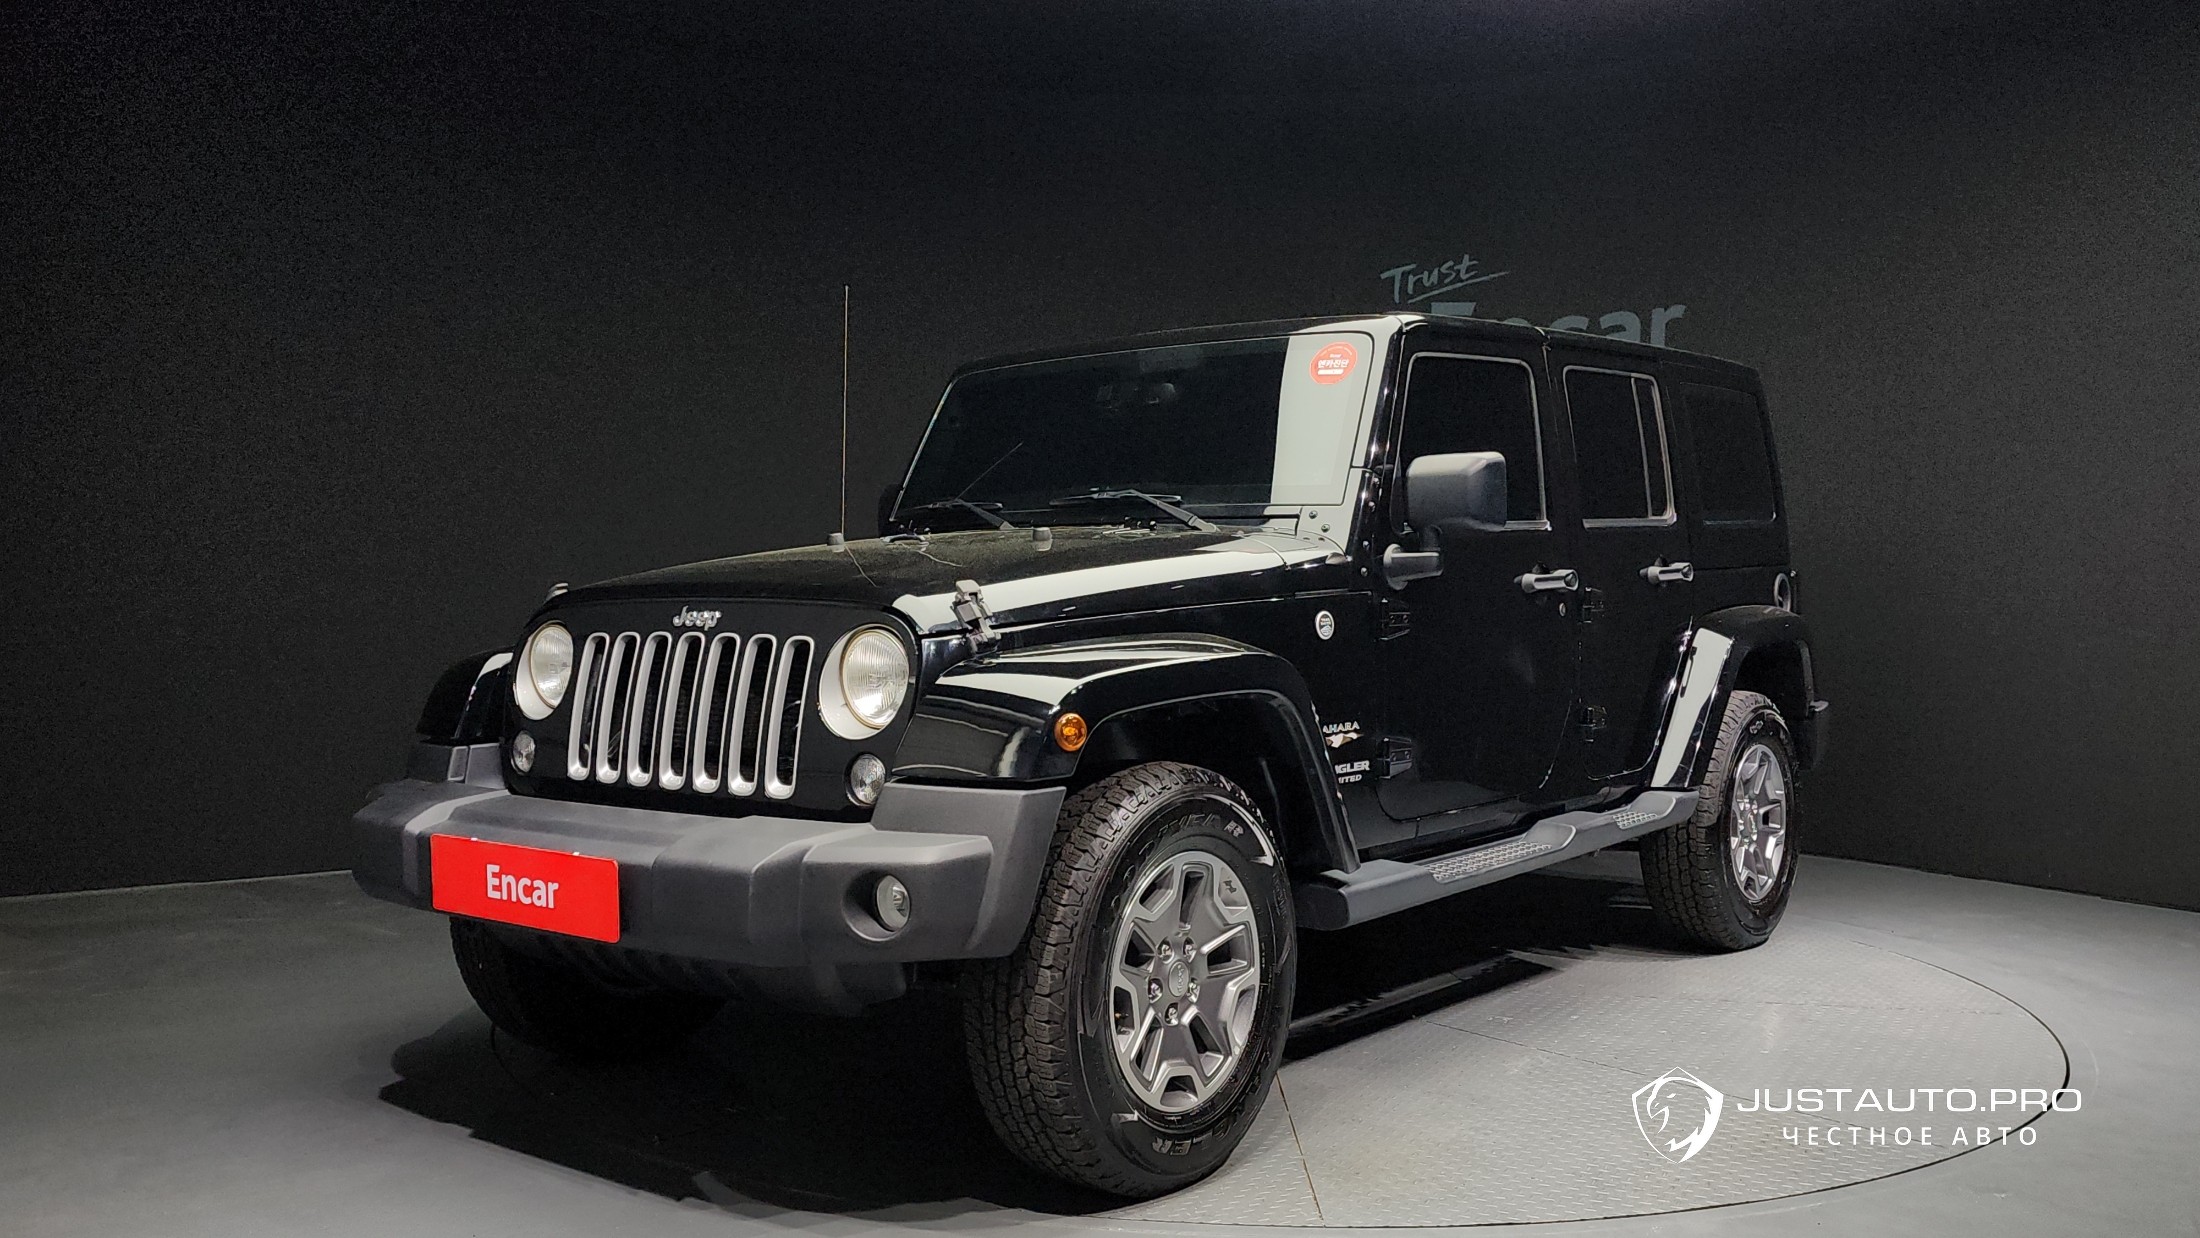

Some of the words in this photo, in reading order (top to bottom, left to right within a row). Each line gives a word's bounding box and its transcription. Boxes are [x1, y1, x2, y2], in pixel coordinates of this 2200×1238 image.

[1380, 253, 1480, 304] Trust
[672, 605, 723, 632] Jeep
[1323, 720, 1361, 734] AHARA
[486, 863, 560, 909] Encar
